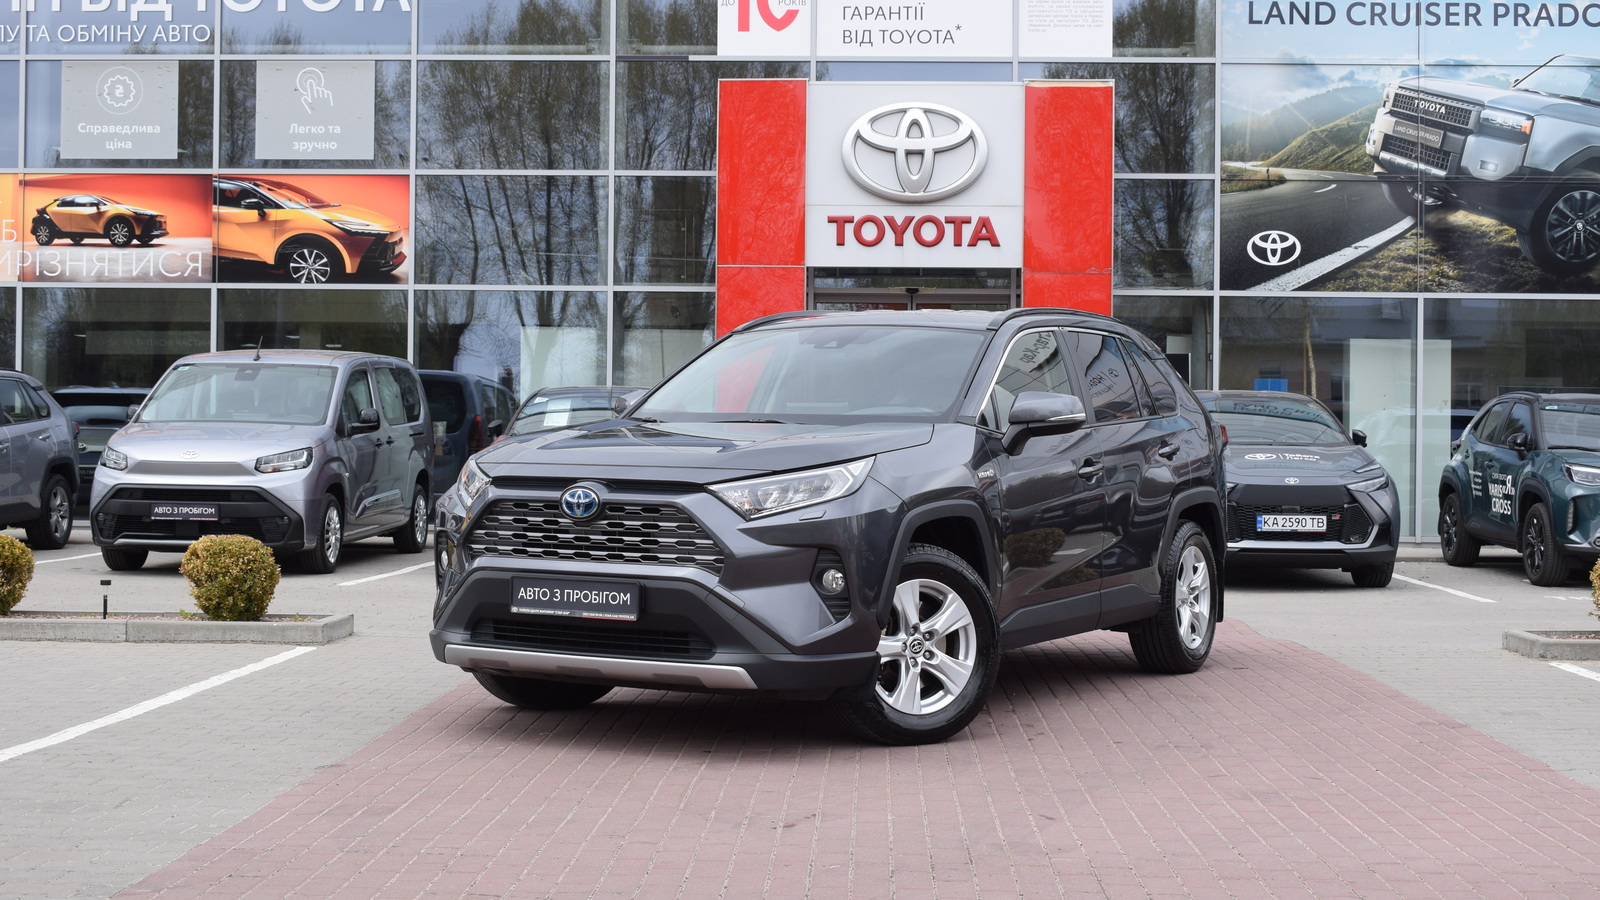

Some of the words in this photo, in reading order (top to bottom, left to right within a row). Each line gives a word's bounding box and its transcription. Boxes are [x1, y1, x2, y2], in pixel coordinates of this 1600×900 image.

[842, 2, 924, 21] ГАРАНТІЇ
[1248, 1, 1337, 25] LAND
[1346, 2, 1483, 27] CRUISER
[26, 24, 51, 42] ТА
[57, 24, 147, 43] ОБМІНУ
[152, 24, 211, 42] АВТО
[842, 29, 874, 47] ВІД
[1414, 100, 1446, 114] TOYOTA
[78, 122, 161, 135] Справедлива
[289, 123, 325, 134] Легко
[327, 125, 341, 134] та
[106, 138, 132, 151] ціна
[292, 141, 338, 152] зручно
[827, 214, 1001, 248] TOYOTA
[1488, 482, 1503, 498] YARIS
[154, 506, 172, 514] АВТО
[173, 506, 178, 514] З
[179, 507, 215, 515] ПРОБІГОМ
[1492, 497, 1511, 515] CROSS
[1263, 517, 1279, 528] KA
[1281, 517, 1307, 528] 2590
[1309, 517, 1325, 528] TB
[518, 587, 550, 601] АВТО
[553, 589, 561, 601] З
[564, 589, 631, 605] ПРОБІГОМ
